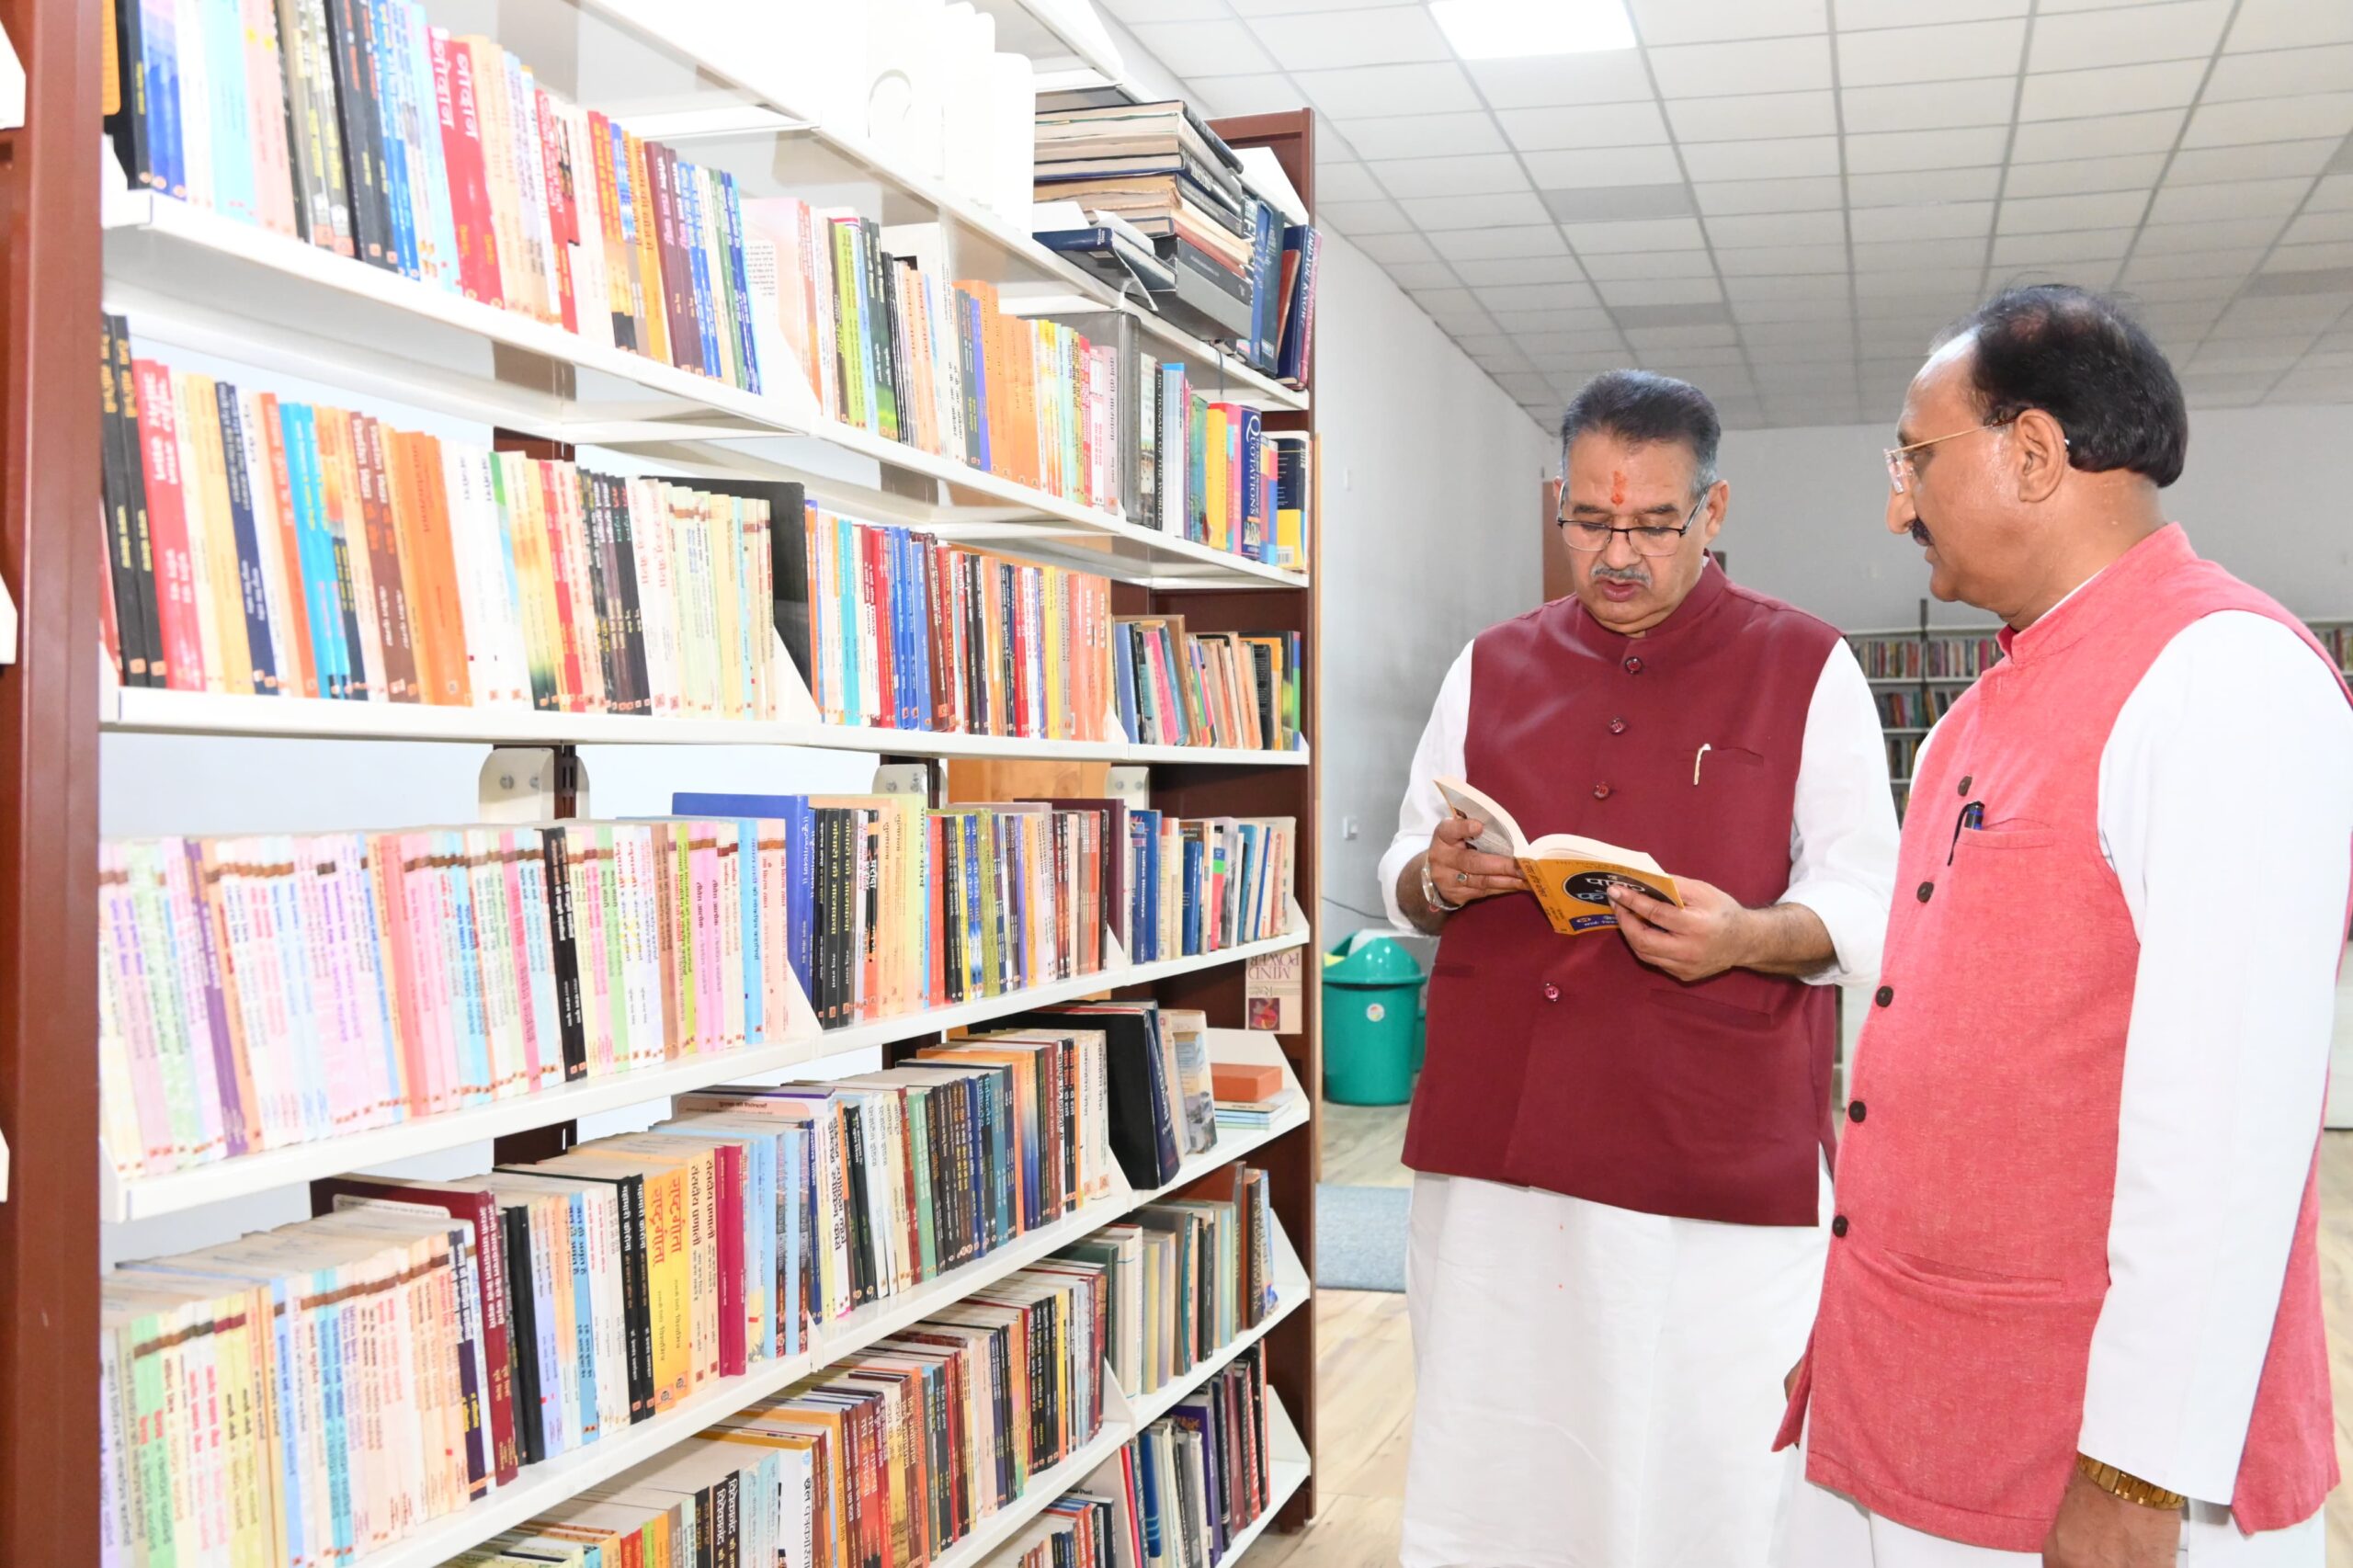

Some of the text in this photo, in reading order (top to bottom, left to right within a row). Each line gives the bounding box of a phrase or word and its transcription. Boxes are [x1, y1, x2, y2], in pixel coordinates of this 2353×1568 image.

[1301, 232, 1315, 327] DID YOU KNOW?
[1245, 415, 1261, 515] QUOTATIONS
[1248, 966, 1290, 980] MIND
[1250, 952, 1300, 967] POWER
[621, 1185, 632, 1219] महामारी
[638, 1184, 646, 1217] महामारी
[649, 1185, 668, 1267] राष्ट्रगीता
[668, 1176, 686, 1254] राष्ट्रगीता
[690, 1165, 702, 1247] संसदीय प्रणाली
[705, 1160, 716, 1240] संसदीय प्रणाली
[622, 1221, 632, 1251] कोरोना
[639, 1220, 647, 1249] कोरोना
[716, 1488, 726, 1545] विवेकानंद
[728, 1478, 738, 1535] विवेकानंद
[729, 1537, 736, 1550] की
